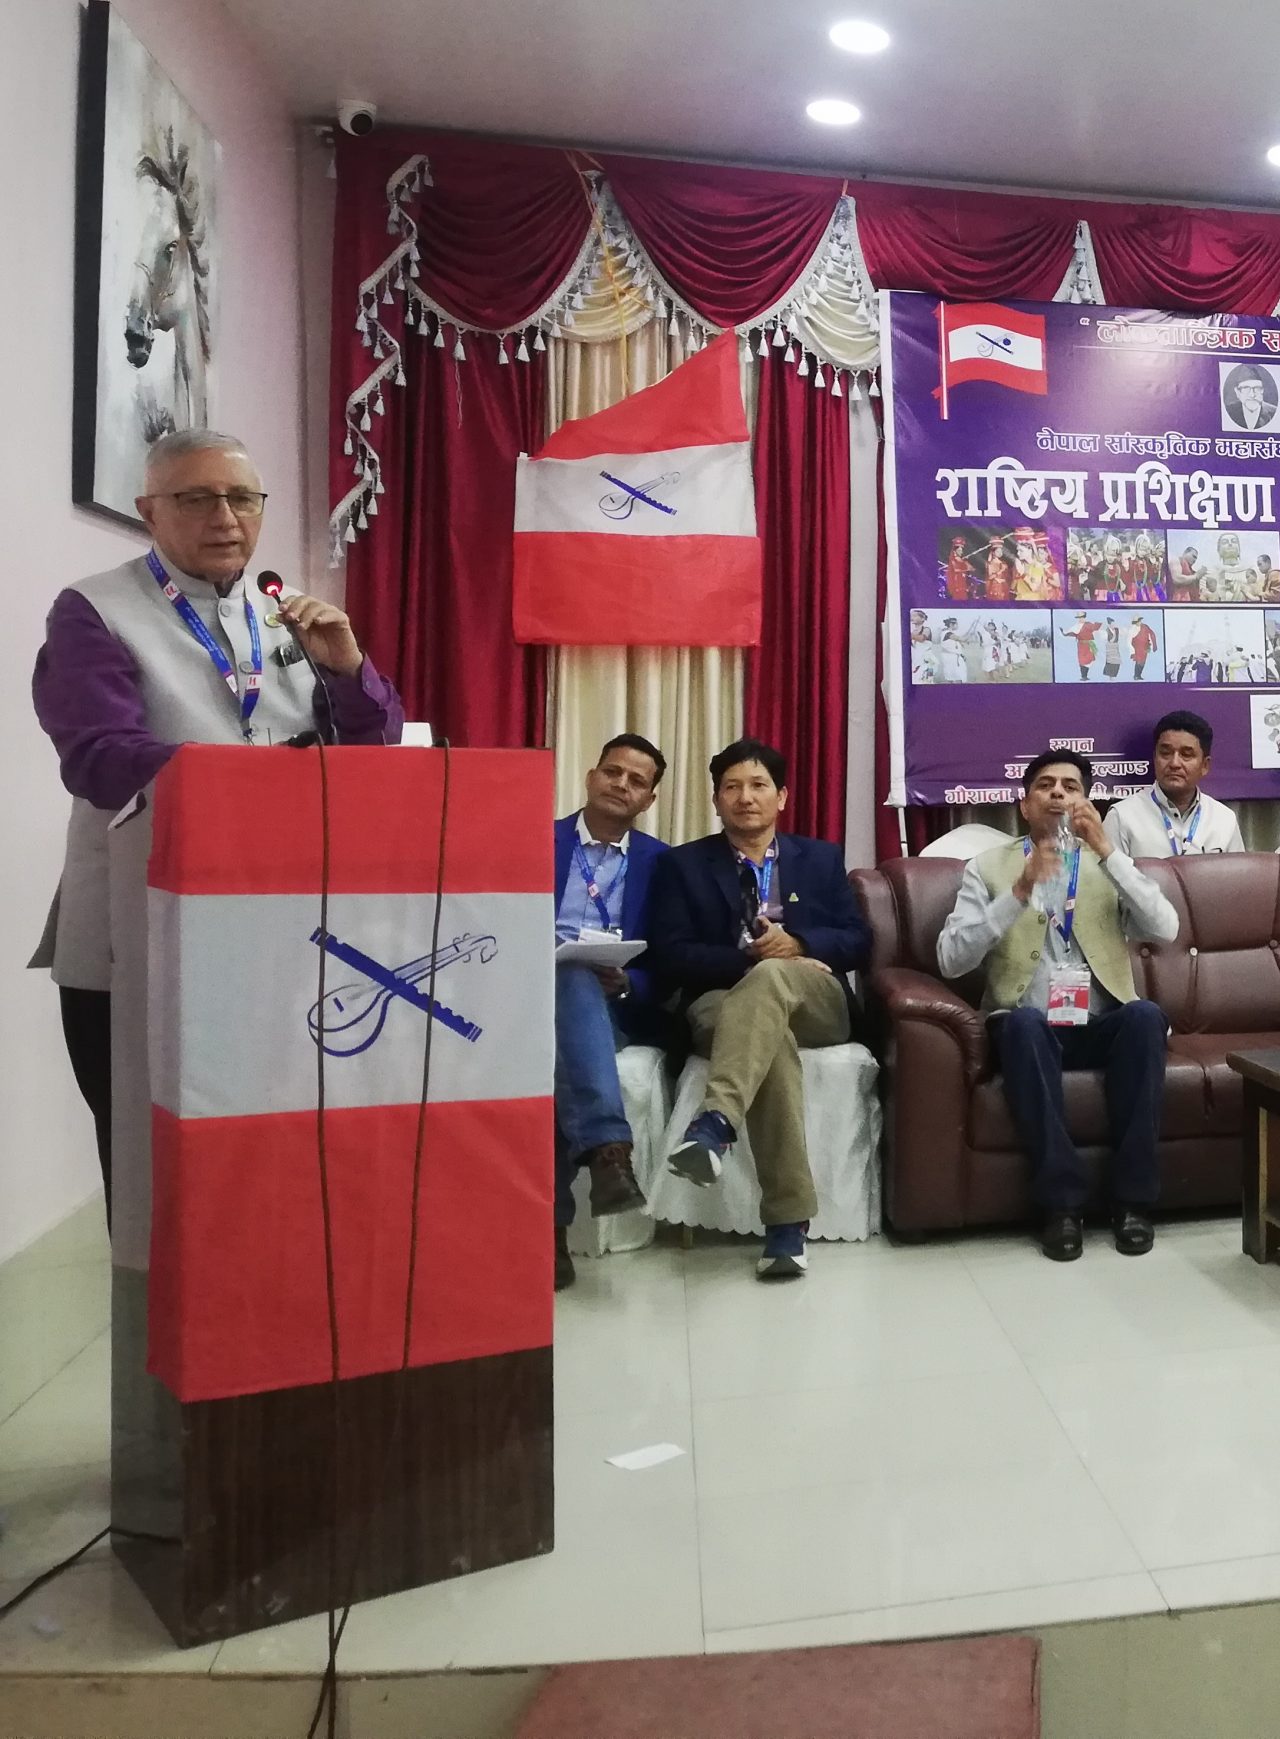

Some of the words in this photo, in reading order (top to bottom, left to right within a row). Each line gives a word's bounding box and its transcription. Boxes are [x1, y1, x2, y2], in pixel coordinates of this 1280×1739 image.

[1036, 427, 1100, 452] नेपाल
[1105, 431, 1211, 459] सांस्कृतिक
[1098, 460, 1276, 529] प्रशिक्षण
[1049, 737, 1095, 753] स्थान
